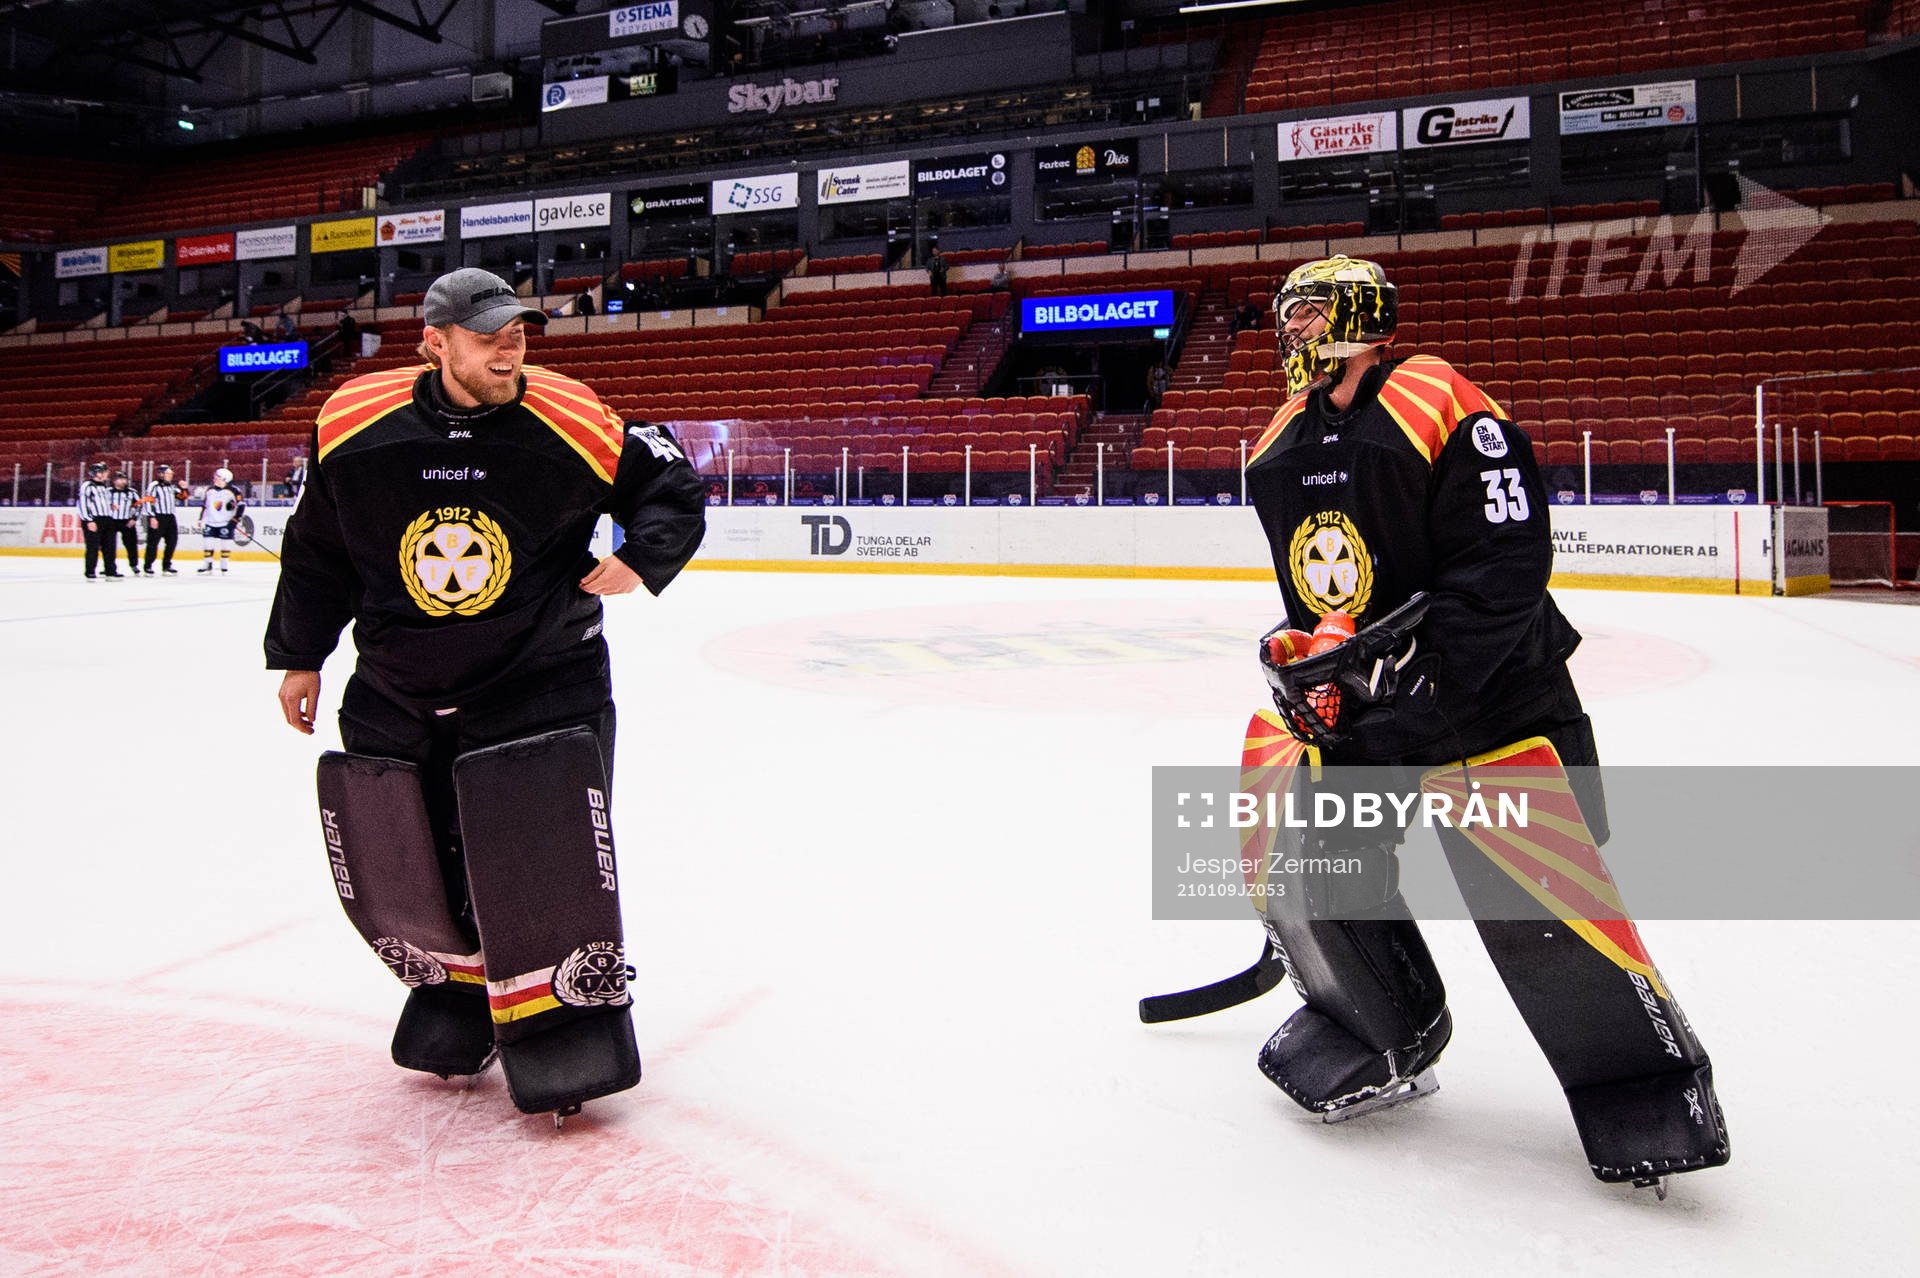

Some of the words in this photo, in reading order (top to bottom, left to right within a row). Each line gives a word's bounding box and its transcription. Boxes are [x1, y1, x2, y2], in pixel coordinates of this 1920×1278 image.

[629, 3, 671, 23] STENA
[614, 20, 673, 35] RECYCLING
[727, 76, 840, 115] Skybar
[1310, 123, 1375, 138] Gästrike
[1417, 107, 1498, 145] Gästrike
[1313, 137, 1345, 150] Plåt
[1350, 134, 1374, 147] AB
[1039, 160, 1071, 170] Fastec
[833, 174, 861, 186] Svensk
[918, 165, 988, 182] BILBOLAGET
[753, 186, 782, 204] SSG
[836, 186, 859, 196] Cater
[462, 211, 531, 228] Handelsbanken
[539, 201, 605, 224] gavle.se
[1505, 216, 1713, 306] ITEM
[1035, 300, 1159, 325] BILBOLAGET
[227, 349, 300, 367] BILBOLAGET
[448, 430, 473, 438] SHL
[1476, 425, 1489, 435] EN
[1322, 434, 1340, 444] SHL
[1479, 433, 1497, 443] BRA
[1482, 441, 1505, 452] START
[422, 466, 469, 480] unicef
[1302, 470, 1337, 486] unicef
[1480, 468, 1530, 524] 33
[435, 507, 471, 522] 1912
[1315, 511, 1341, 525] 1912
[447, 533, 460, 549] B
[801, 515, 852, 555] TD
[856, 536, 893, 546] TUNGA
[896, 536, 931, 546] DELAR
[856, 547, 901, 557] SVERIGE
[904, 547, 918, 557] AB
[1697, 546, 1718, 557] AB
[587, 787, 616, 892] BAUER
[321, 808, 354, 899] BAUER
[587, 941, 614, 951] 1912
[597, 957, 607, 967] B
[1627, 970, 1682, 1058] BAUER
